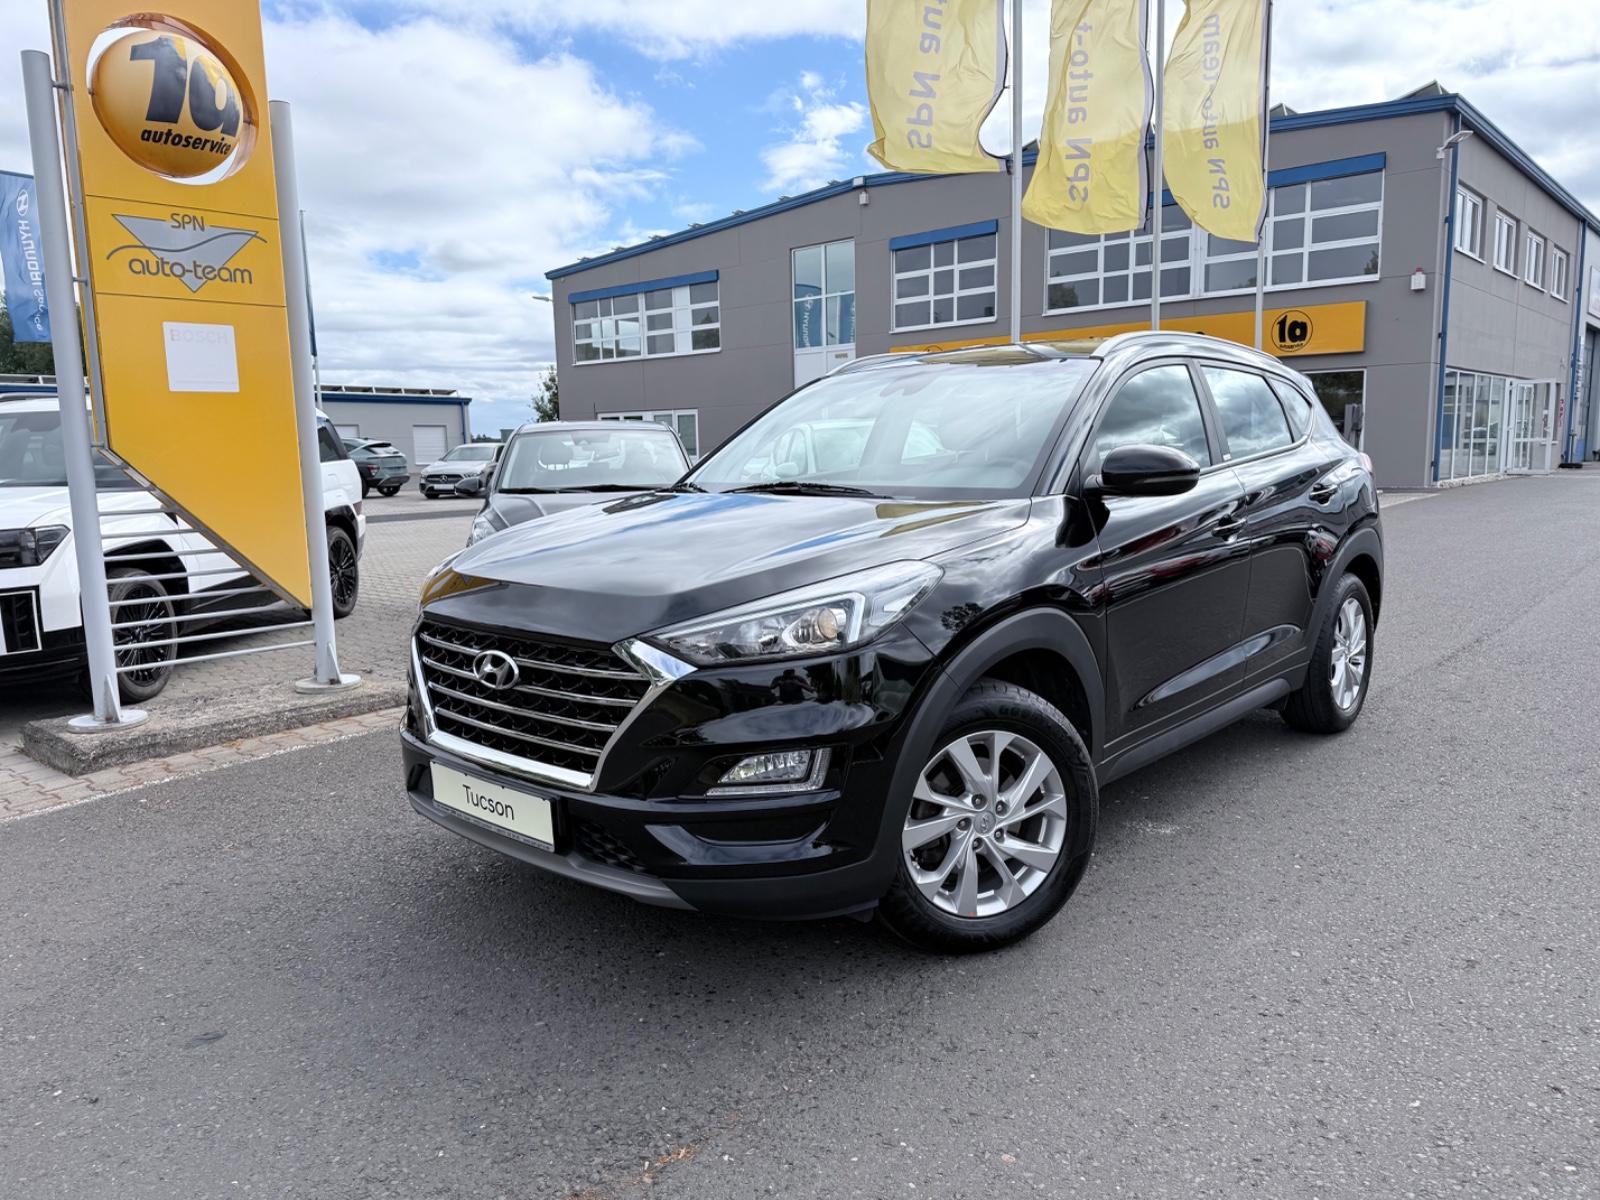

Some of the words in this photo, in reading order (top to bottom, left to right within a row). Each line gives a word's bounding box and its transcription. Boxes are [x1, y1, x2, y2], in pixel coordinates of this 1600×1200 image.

[140, 127, 232, 156] autoservice
[169, 212, 205, 232] SPN
[128, 256, 253, 285] auto-team
[169, 328, 228, 344] BOSCH
[1277, 314, 1308, 343] 1a
[462, 783, 515, 820] Tucson
